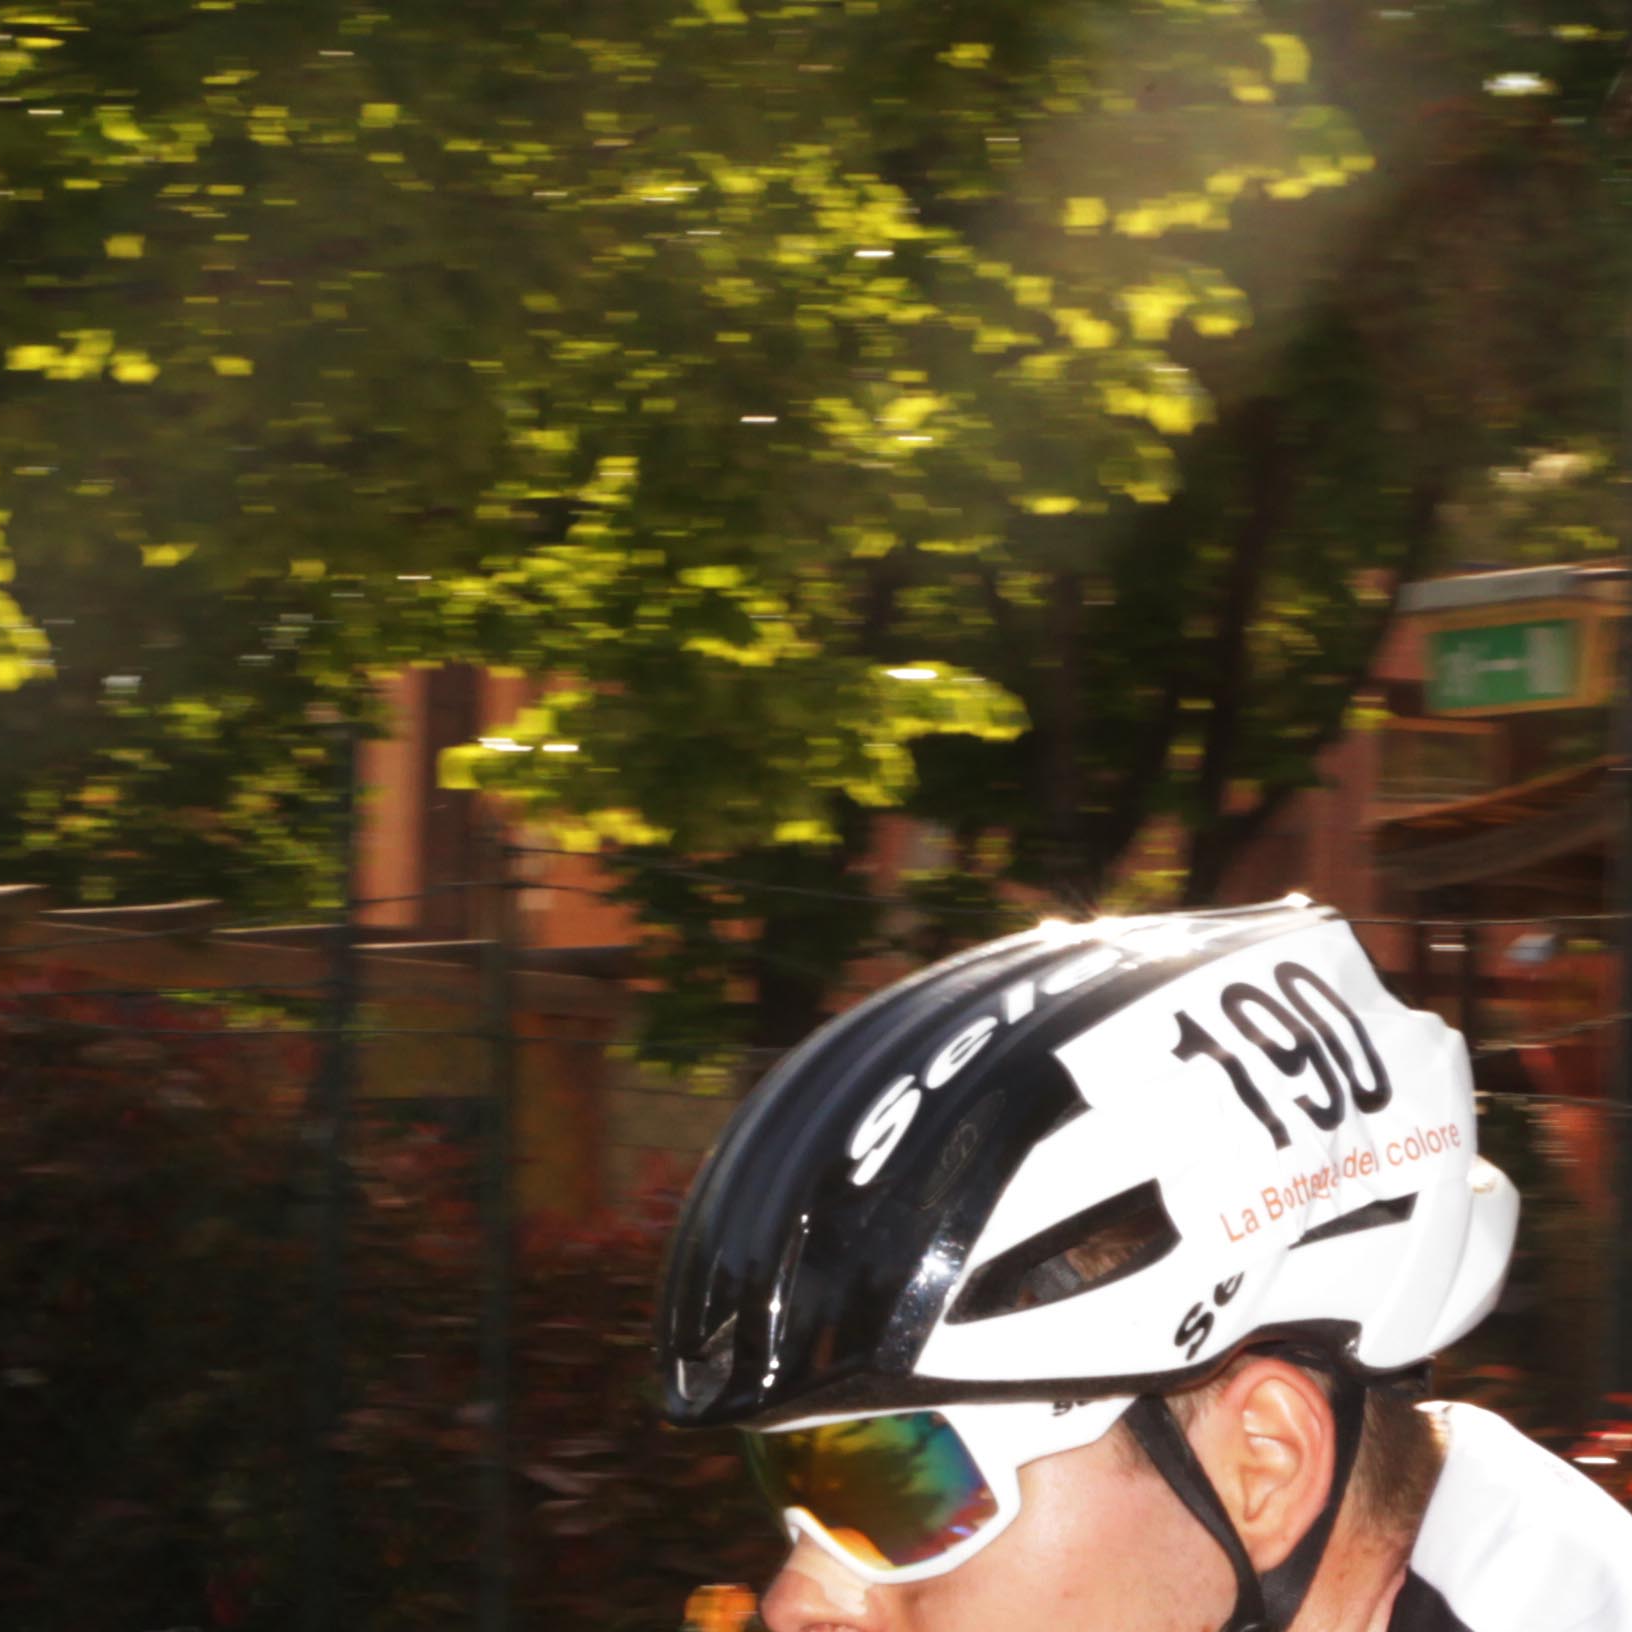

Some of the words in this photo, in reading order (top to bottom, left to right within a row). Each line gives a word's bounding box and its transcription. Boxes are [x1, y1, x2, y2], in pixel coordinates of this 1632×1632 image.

[1171, 961, 1392, 1150] 190
[1220, 1207, 1261, 1241] La
[1342, 1140, 1380, 1178] del
[1386, 1122, 1461, 1166] colore
